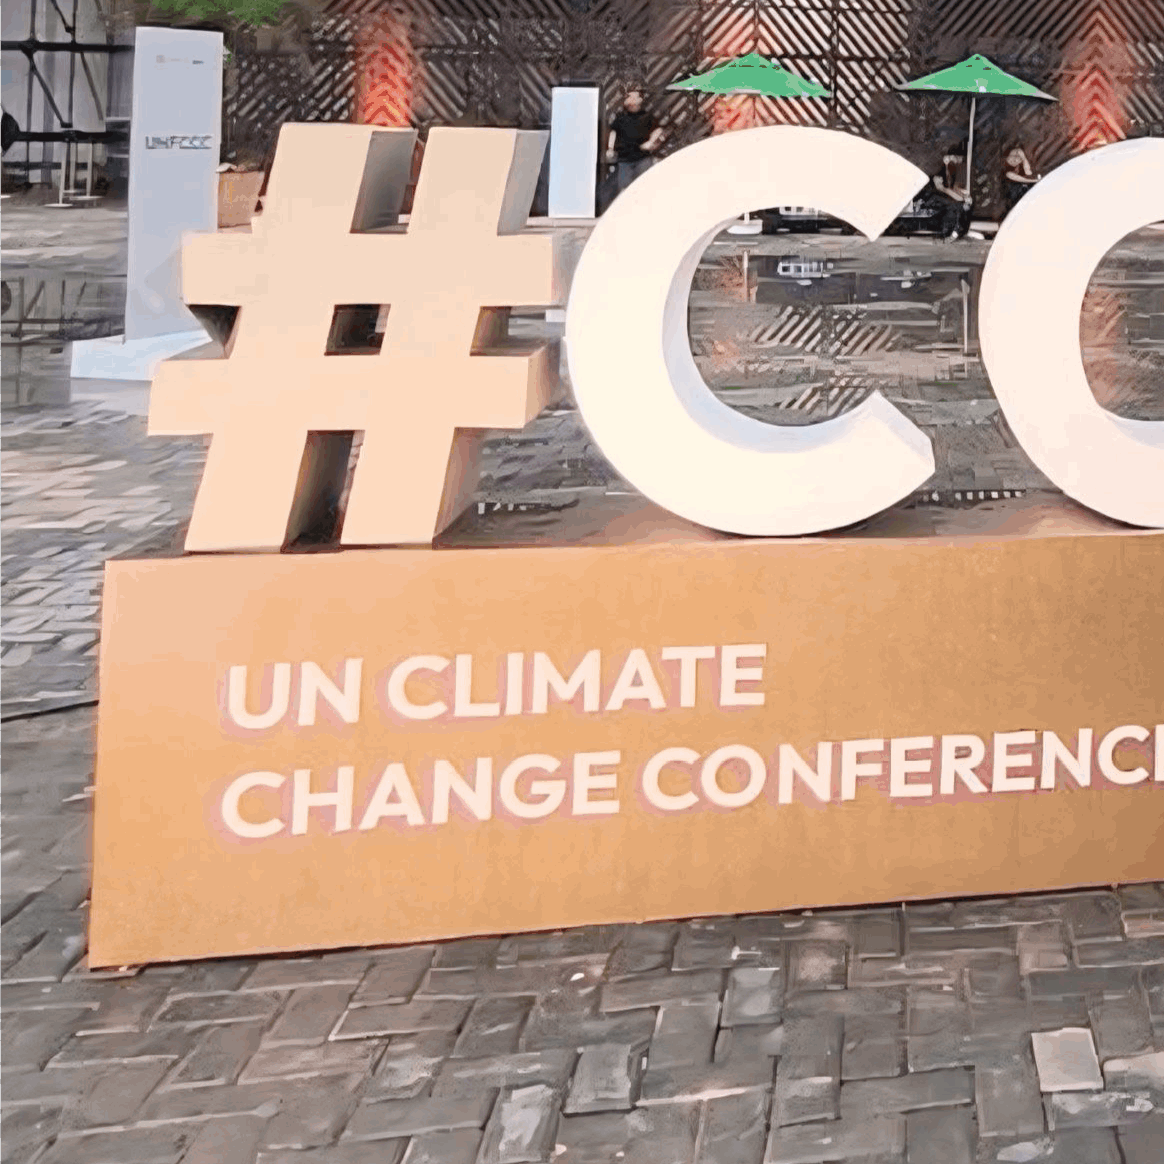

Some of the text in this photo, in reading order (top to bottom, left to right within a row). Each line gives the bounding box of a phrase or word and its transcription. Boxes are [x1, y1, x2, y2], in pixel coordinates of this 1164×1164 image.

[227, 643, 767, 729] UN CLIMATE
[221, 750, 622, 838] CHANGE
